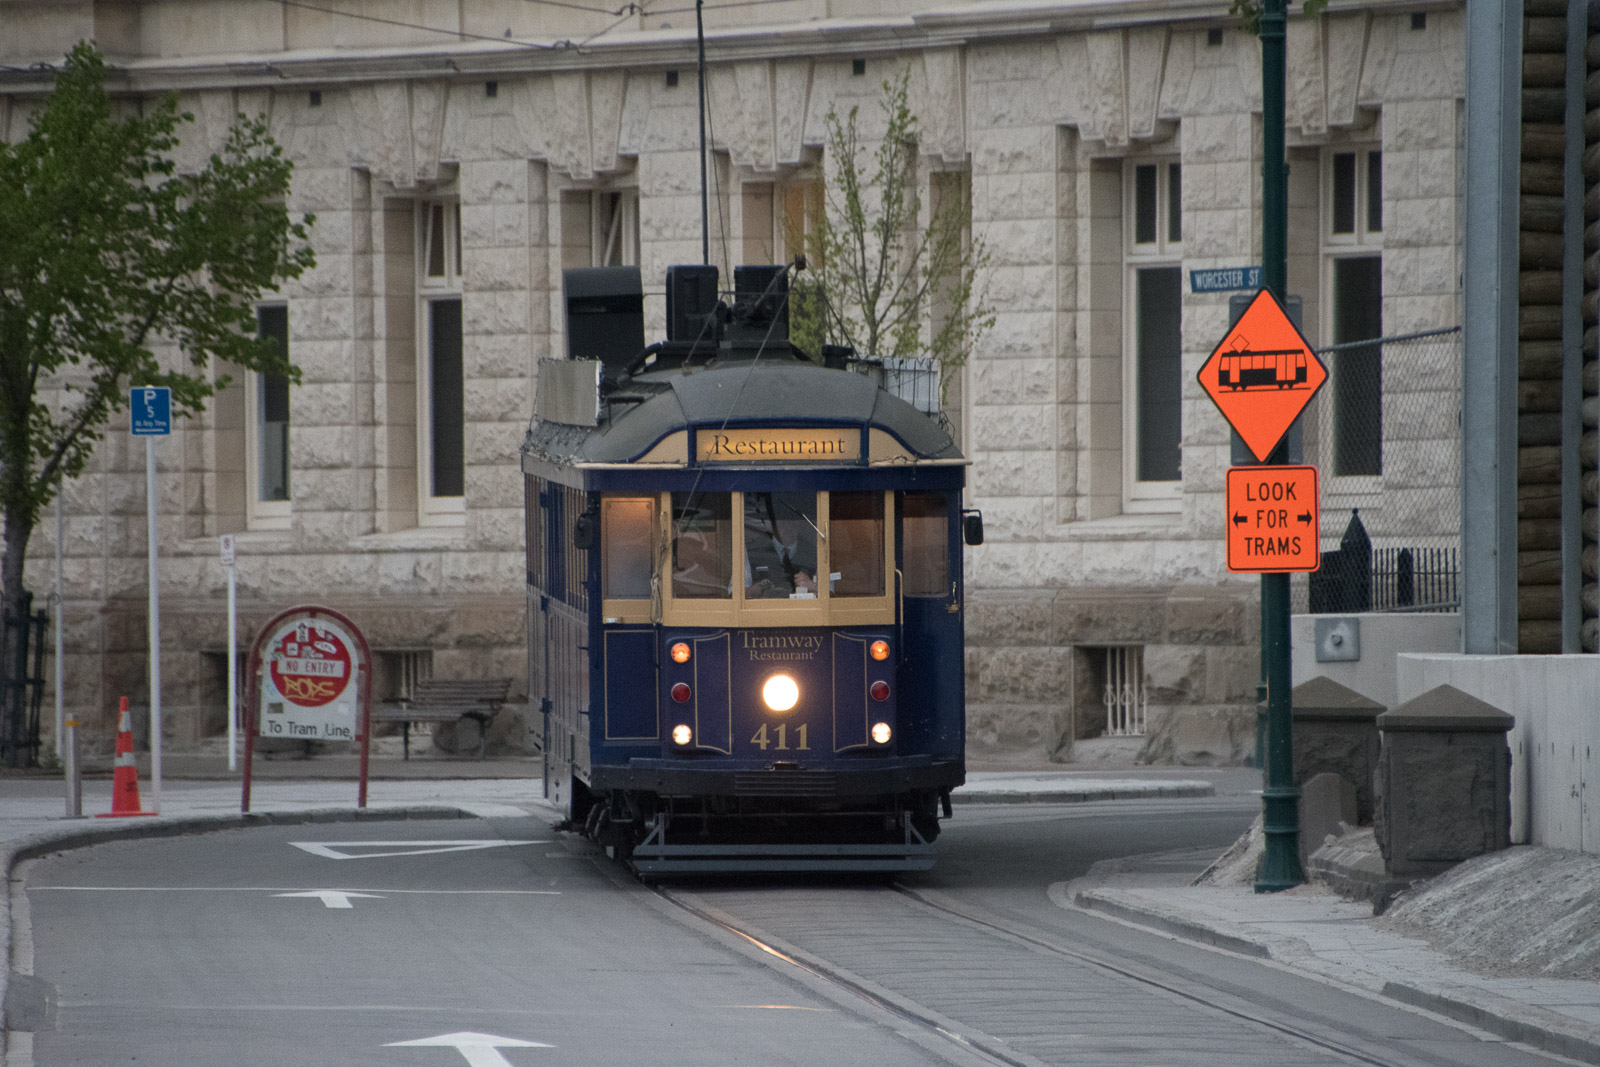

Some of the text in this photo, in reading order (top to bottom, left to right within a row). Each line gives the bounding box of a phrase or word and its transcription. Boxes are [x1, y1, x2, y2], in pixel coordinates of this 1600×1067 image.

[1195, 269, 1259, 289] WORCESTER ST
[144, 390, 156, 405] P
[707, 434, 846, 455] Restaurant
[1246, 482, 1297, 501] LOOK
[1256, 509, 1288, 528] FOR
[1244, 536, 1302, 556] TRAMS
[738, 630, 823, 652] Tramway
[749, 649, 814, 661] Restaurant
[286, 660, 336, 674] NO ENTRY
[268, 720, 350, 737] To Tram Line
[750, 723, 811, 750] 411
